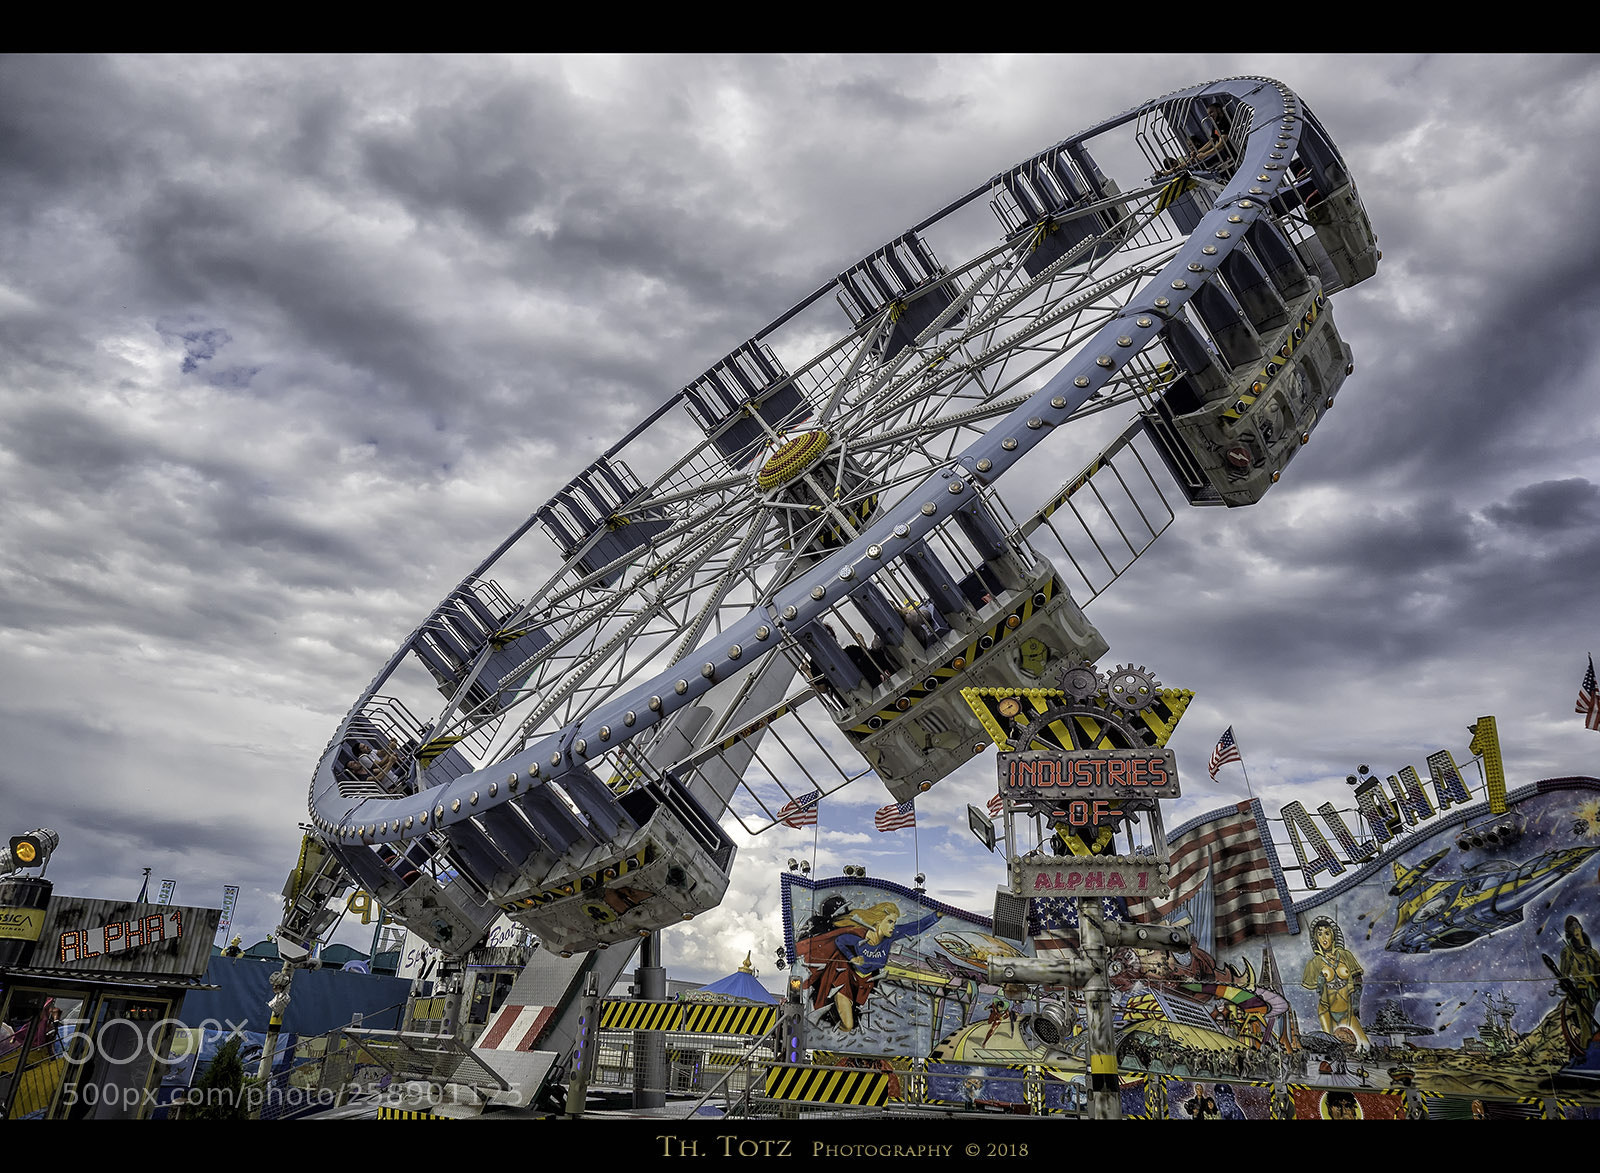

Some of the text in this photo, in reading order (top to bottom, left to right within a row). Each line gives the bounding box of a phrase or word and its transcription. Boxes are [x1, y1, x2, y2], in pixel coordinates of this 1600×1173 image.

[1009, 759, 1168, 787] INDUSTRIES
[1280, 715, 1507, 890] ALPHA 1
[1034, 871, 1149, 892] ALPHA 1
[60, 909, 182, 965] ALPHA 1
